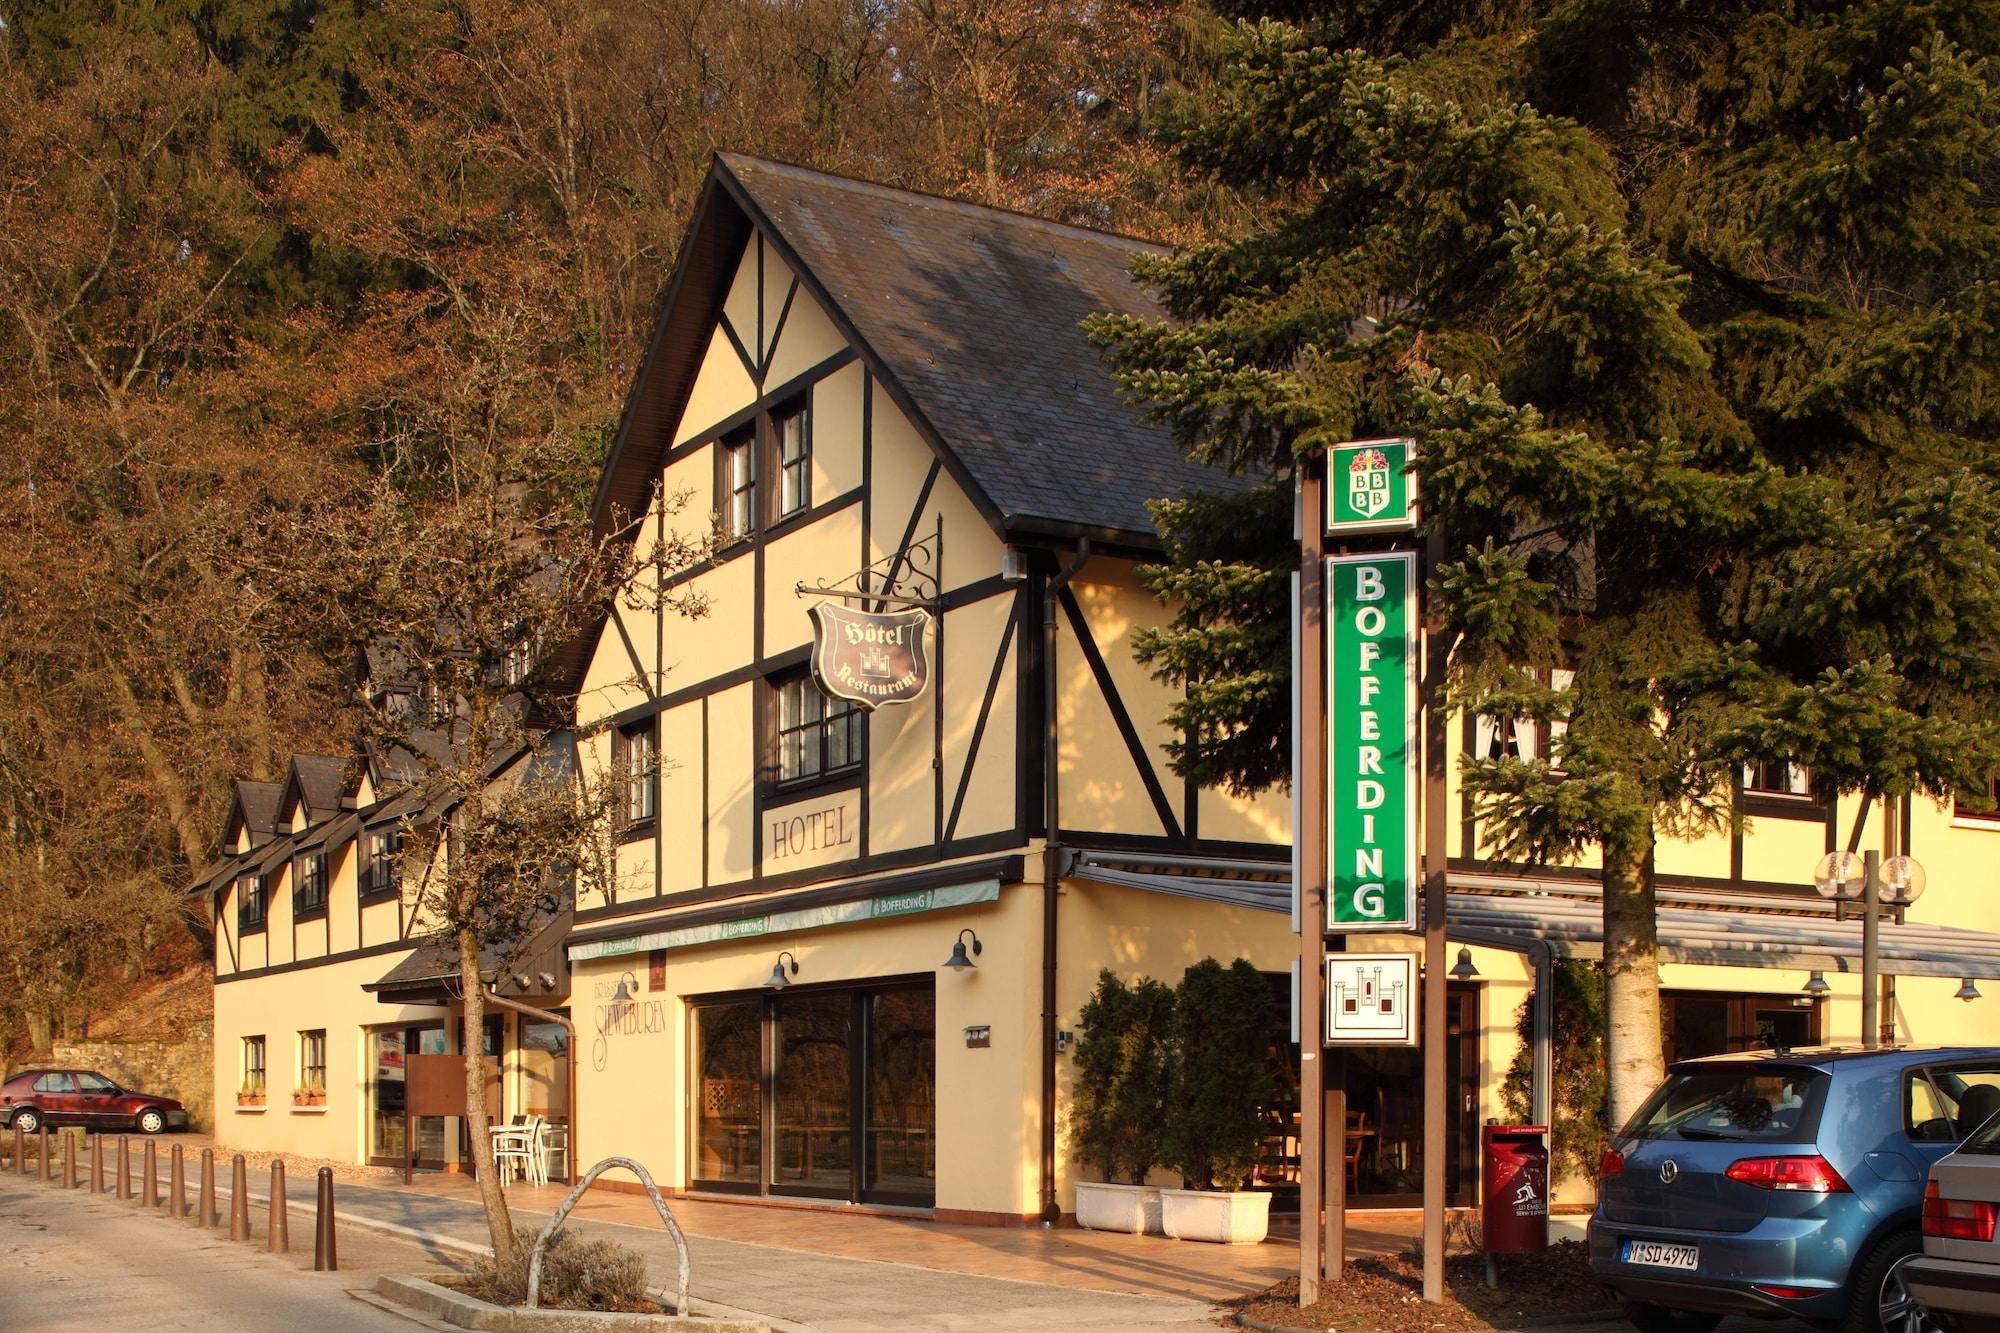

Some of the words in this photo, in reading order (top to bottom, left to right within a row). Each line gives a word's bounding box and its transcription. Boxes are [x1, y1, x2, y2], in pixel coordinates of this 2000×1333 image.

[844, 621, 904, 645] Hôtel
[836, 662, 918, 695] Restaurant
[1353, 566, 1386, 919] BOFFERDING
[772, 805, 853, 860] HOTEL
[880, 894, 925, 913] BOFFERDING
[1664, 1246, 1697, 1266] 4970
